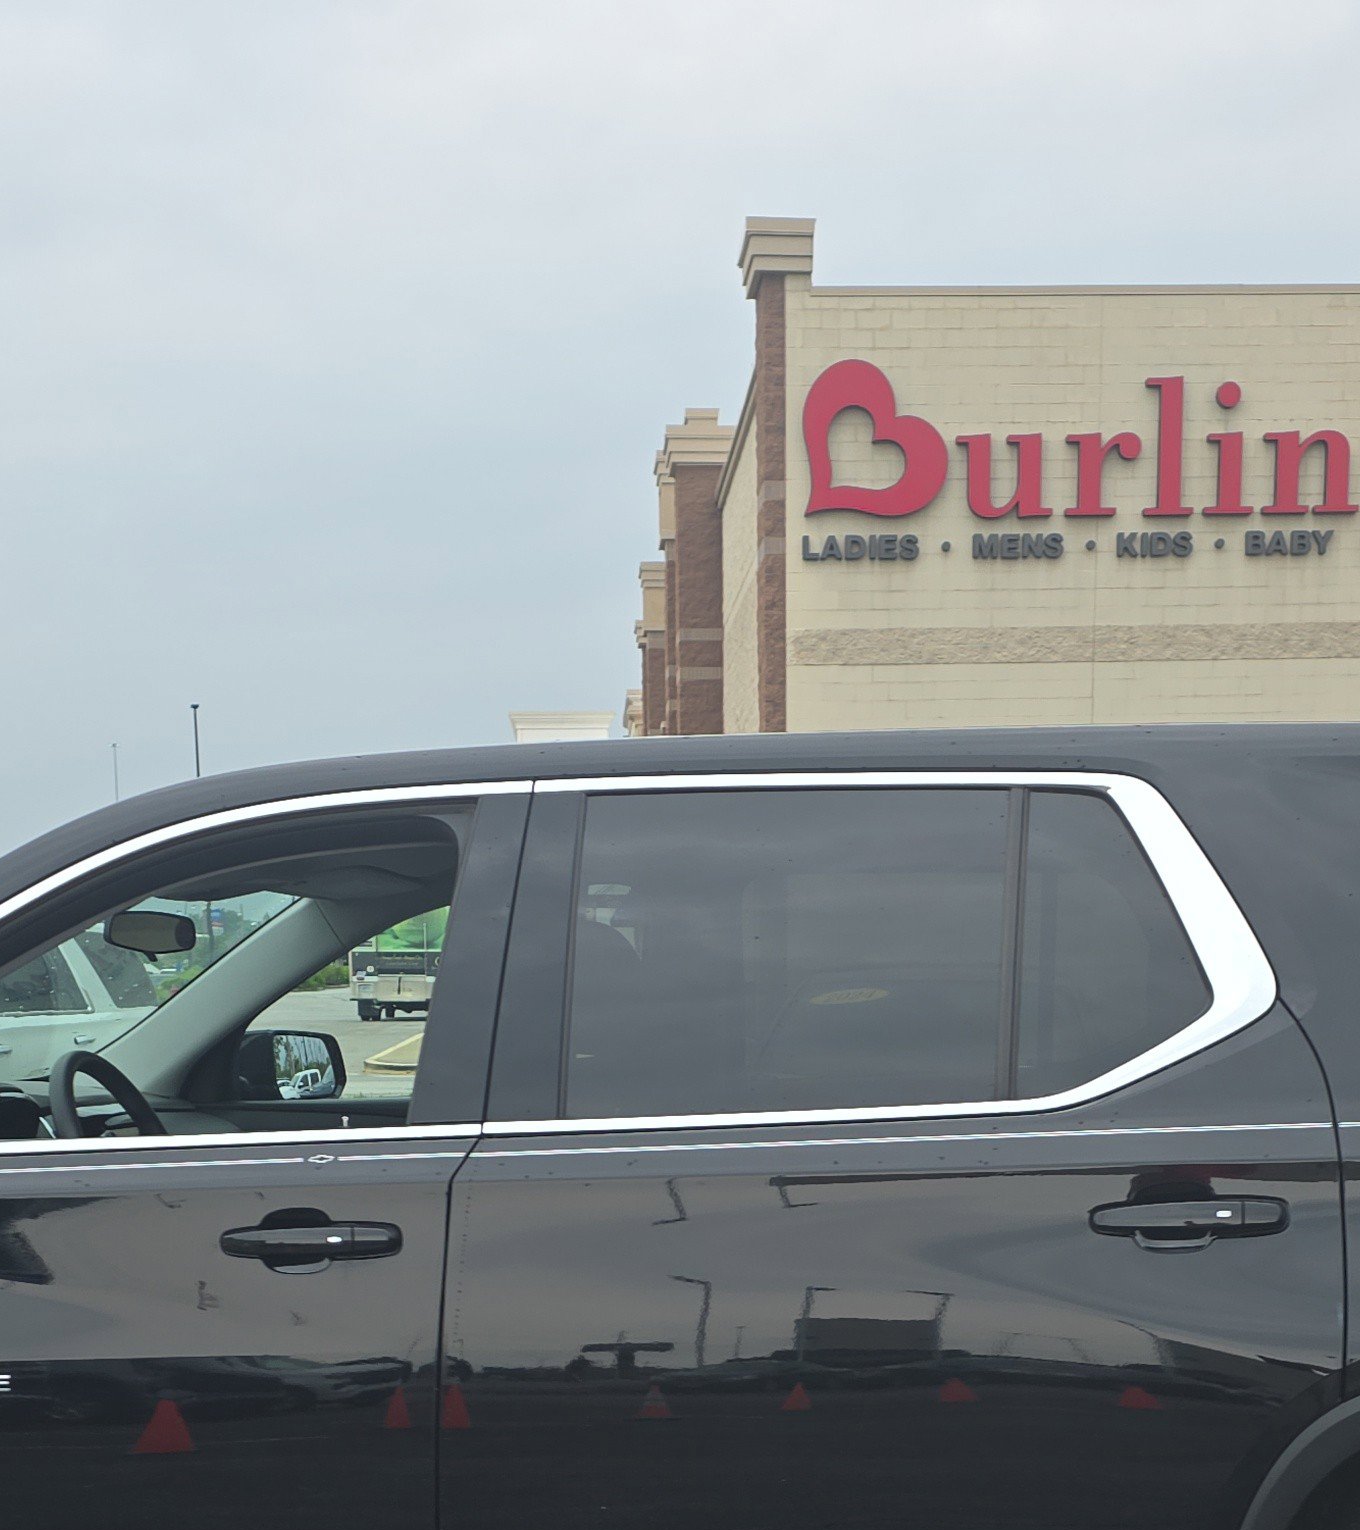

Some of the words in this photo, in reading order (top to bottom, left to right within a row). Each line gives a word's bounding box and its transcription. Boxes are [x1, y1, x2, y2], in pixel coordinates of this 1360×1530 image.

[801, 533, 921, 562] LADIES
[971, 532, 1065, 561] MENS
[1115, 530, 1194, 559] KIDS
[1243, 529, 1335, 557] BABY
